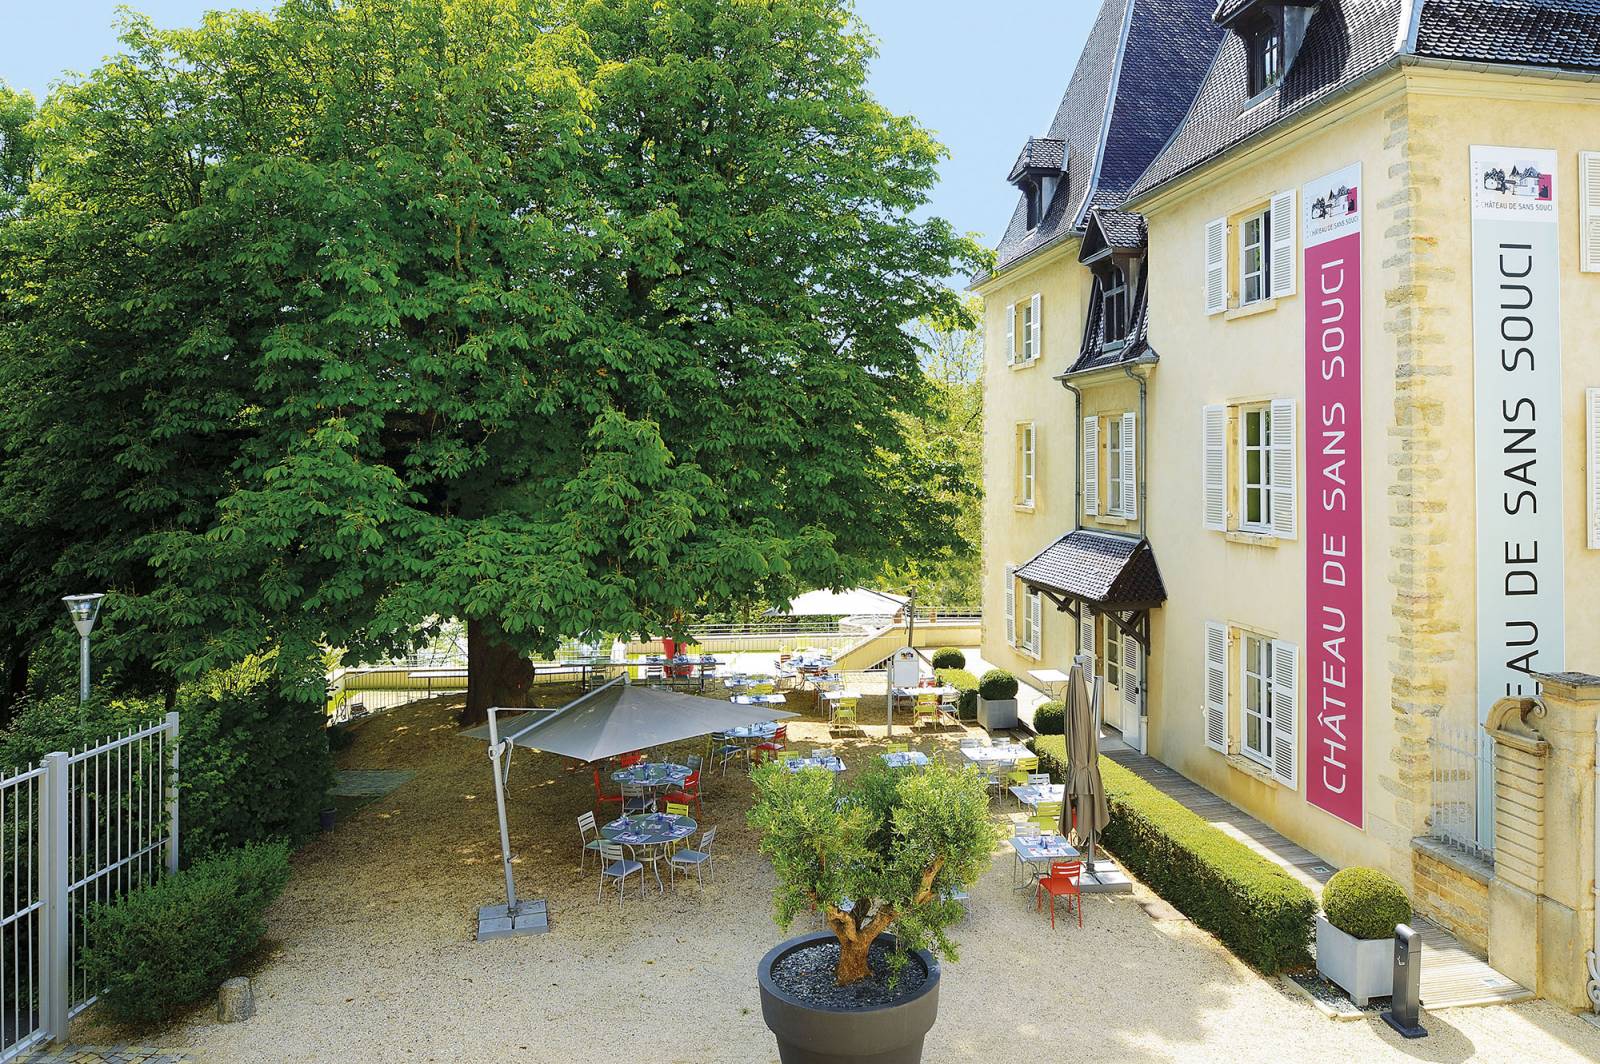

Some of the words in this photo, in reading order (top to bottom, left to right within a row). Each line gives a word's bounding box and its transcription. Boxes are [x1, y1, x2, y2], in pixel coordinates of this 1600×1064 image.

[1509, 202, 1517, 210] DE
[1518, 202, 1534, 211] SANS
[1321, 258, 1344, 378] SOUCI
[1499, 243, 1535, 372] SOUCI
[1322, 402, 1345, 511] SANS
[1502, 397, 1538, 515] SANS
[1322, 533, 1346, 587] DE
[1504, 540, 1538, 596] DE
[1317, 605, 1346, 795] CHÂTEAU
[1505, 620, 1539, 697] EAU
